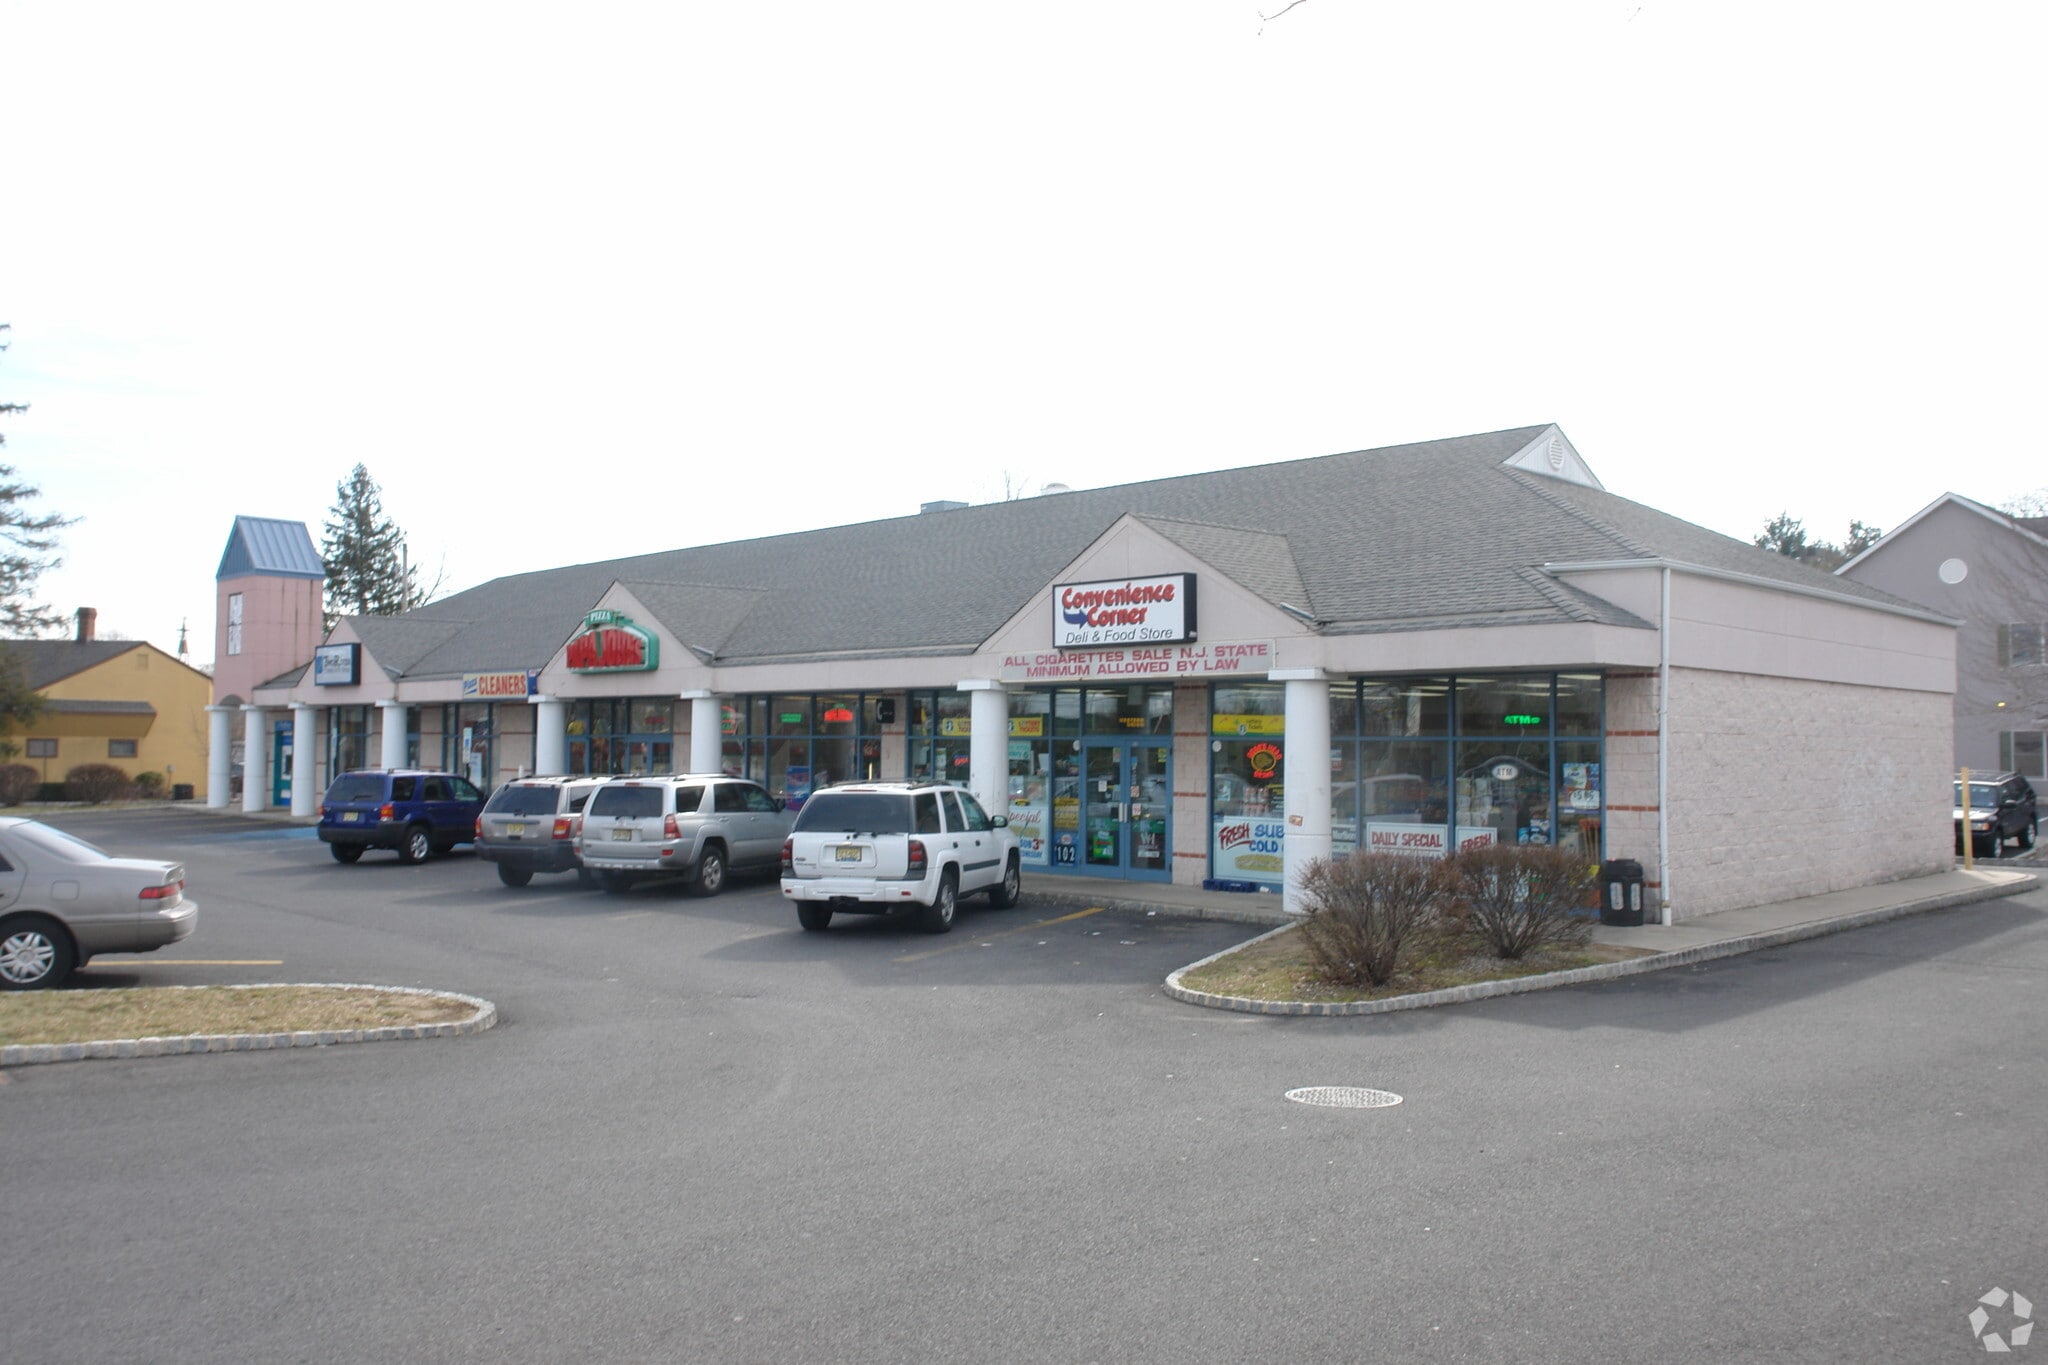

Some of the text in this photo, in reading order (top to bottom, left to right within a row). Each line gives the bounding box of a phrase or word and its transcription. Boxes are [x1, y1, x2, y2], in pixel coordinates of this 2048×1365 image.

[1062, 582, 1175, 609] Convenience
[590, 610, 611, 622] PIZZA
[1087, 605, 1147, 627] Corner
[1066, 628, 1173, 644] Deli & Food Store
[1004, 644, 1268, 667] ALL CIGARETTES SALE N.J. STATE
[1026, 659, 1239, 677] MINIMUM ALLOWED BY LAW
[479, 674, 527, 695] CLEANERS
[1218, 822, 1250, 850] FRESH
[1371, 831, 1443, 848] DAILY SPECIAL
[1249, 840, 1279, 853] COLD
